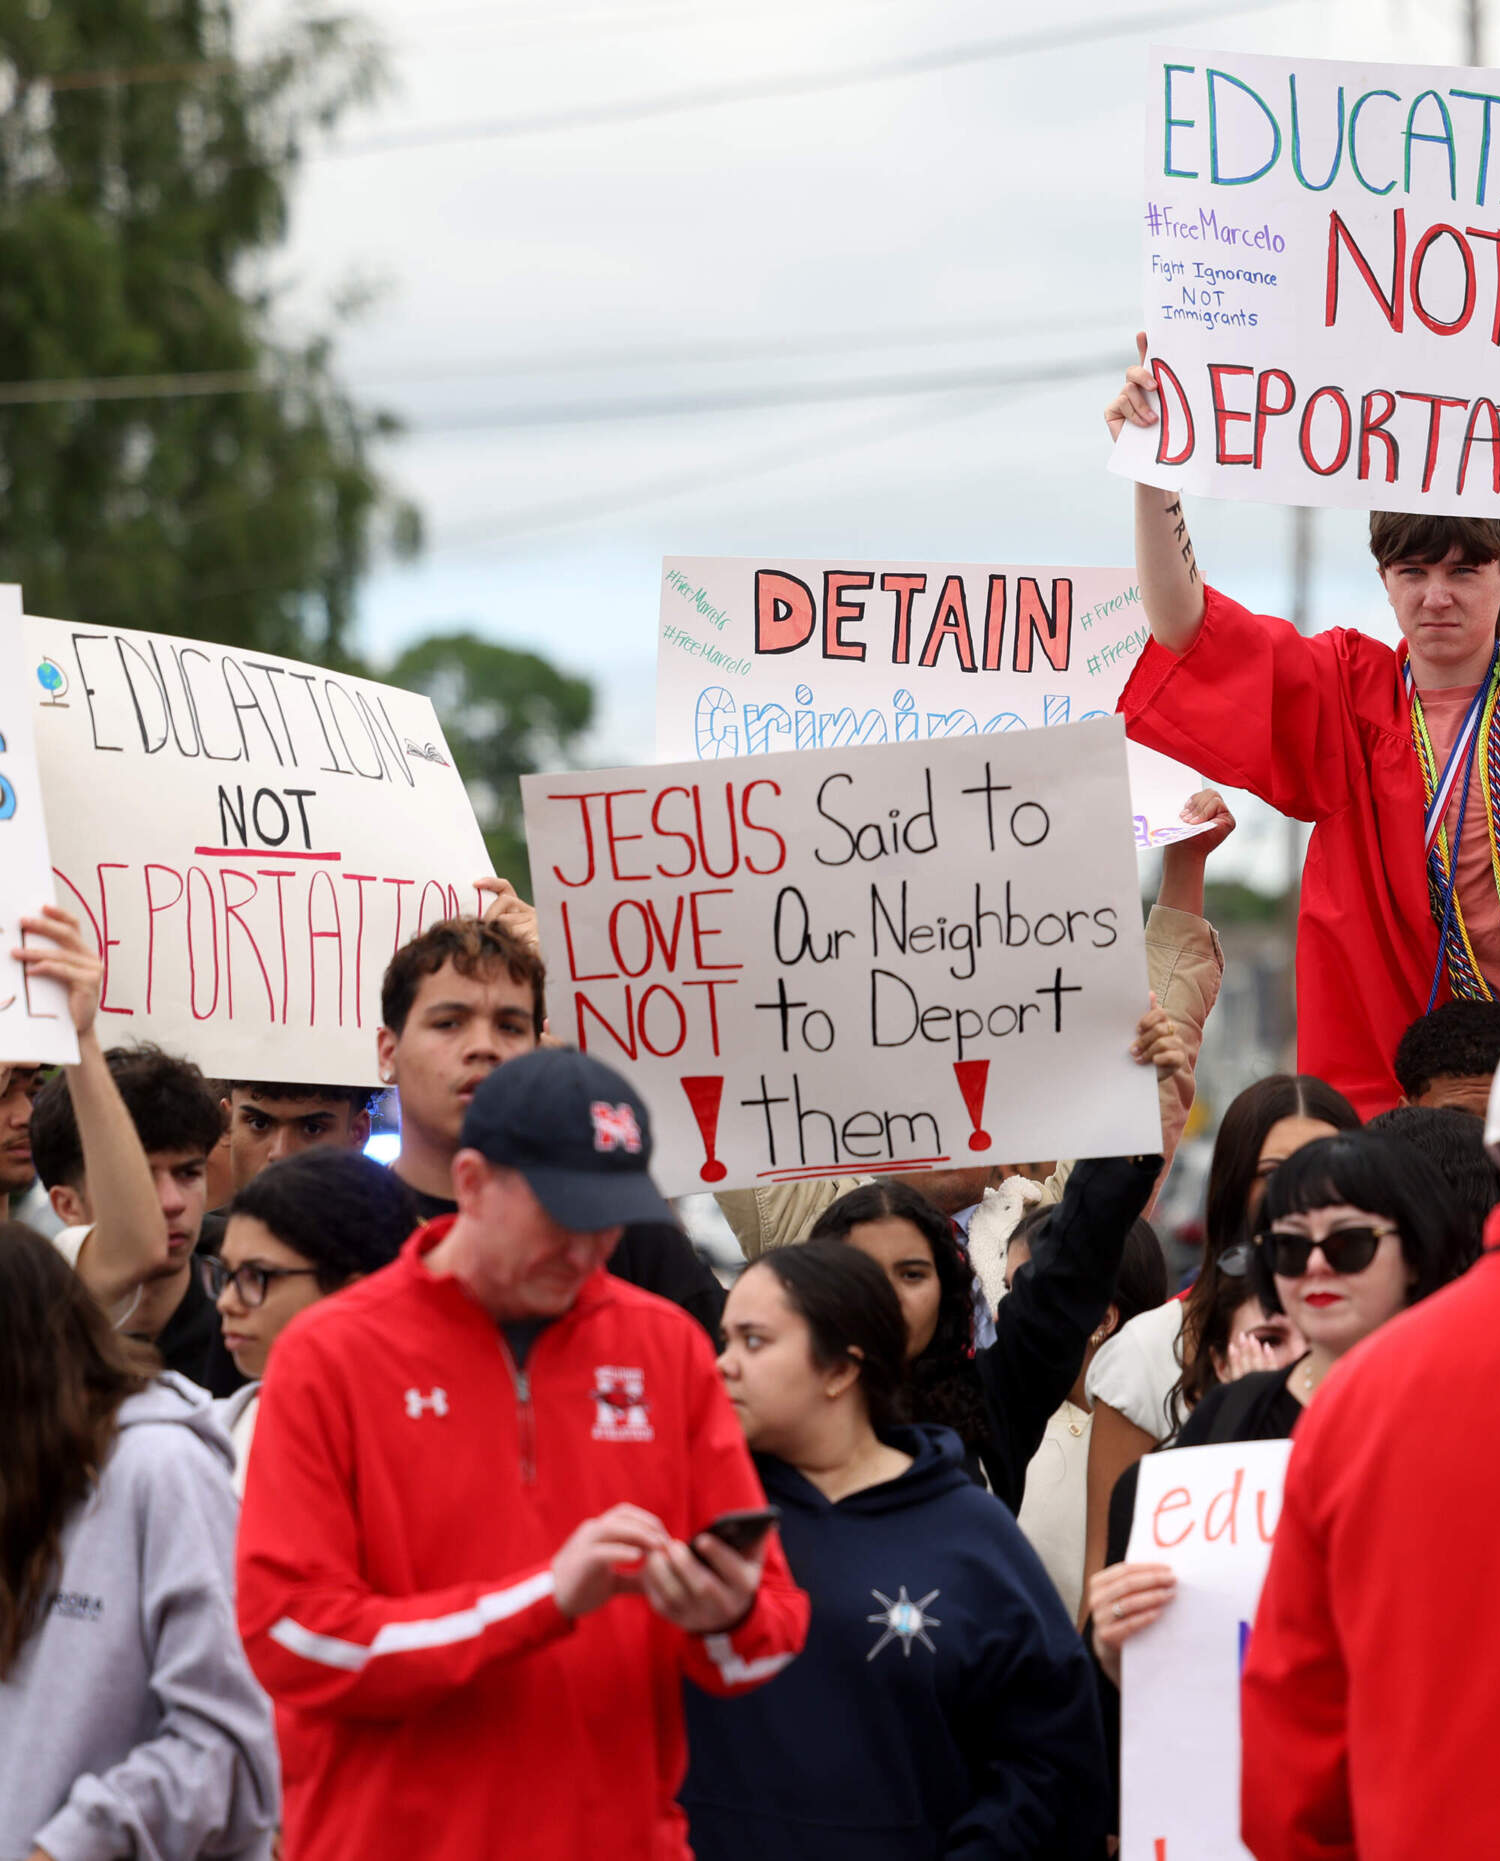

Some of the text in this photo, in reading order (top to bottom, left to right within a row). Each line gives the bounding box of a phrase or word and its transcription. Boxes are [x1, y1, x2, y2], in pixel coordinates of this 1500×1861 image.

[1144, 201, 1286, 253] #FreeMarcelo
[1152, 254, 1278, 287] Fight Ignorance
[1161, 305, 1259, 330] Immigrants
[1182, 286, 1225, 307] NOT
[754, 569, 1073, 674] DETAIN
[72, 633, 416, 788] EDUCATION
[695, 685, 1115, 761] Crimin
[218, 785, 317, 850] NOT
[547, 761, 1051, 889] JESUS Said to
[52, 862, 485, 1032] EPORTATI
[561, 880, 1120, 983] LOVE Our Neighbors
[574, 966, 1084, 1062] NOT to Deport
[740, 1072, 943, 1167] them
